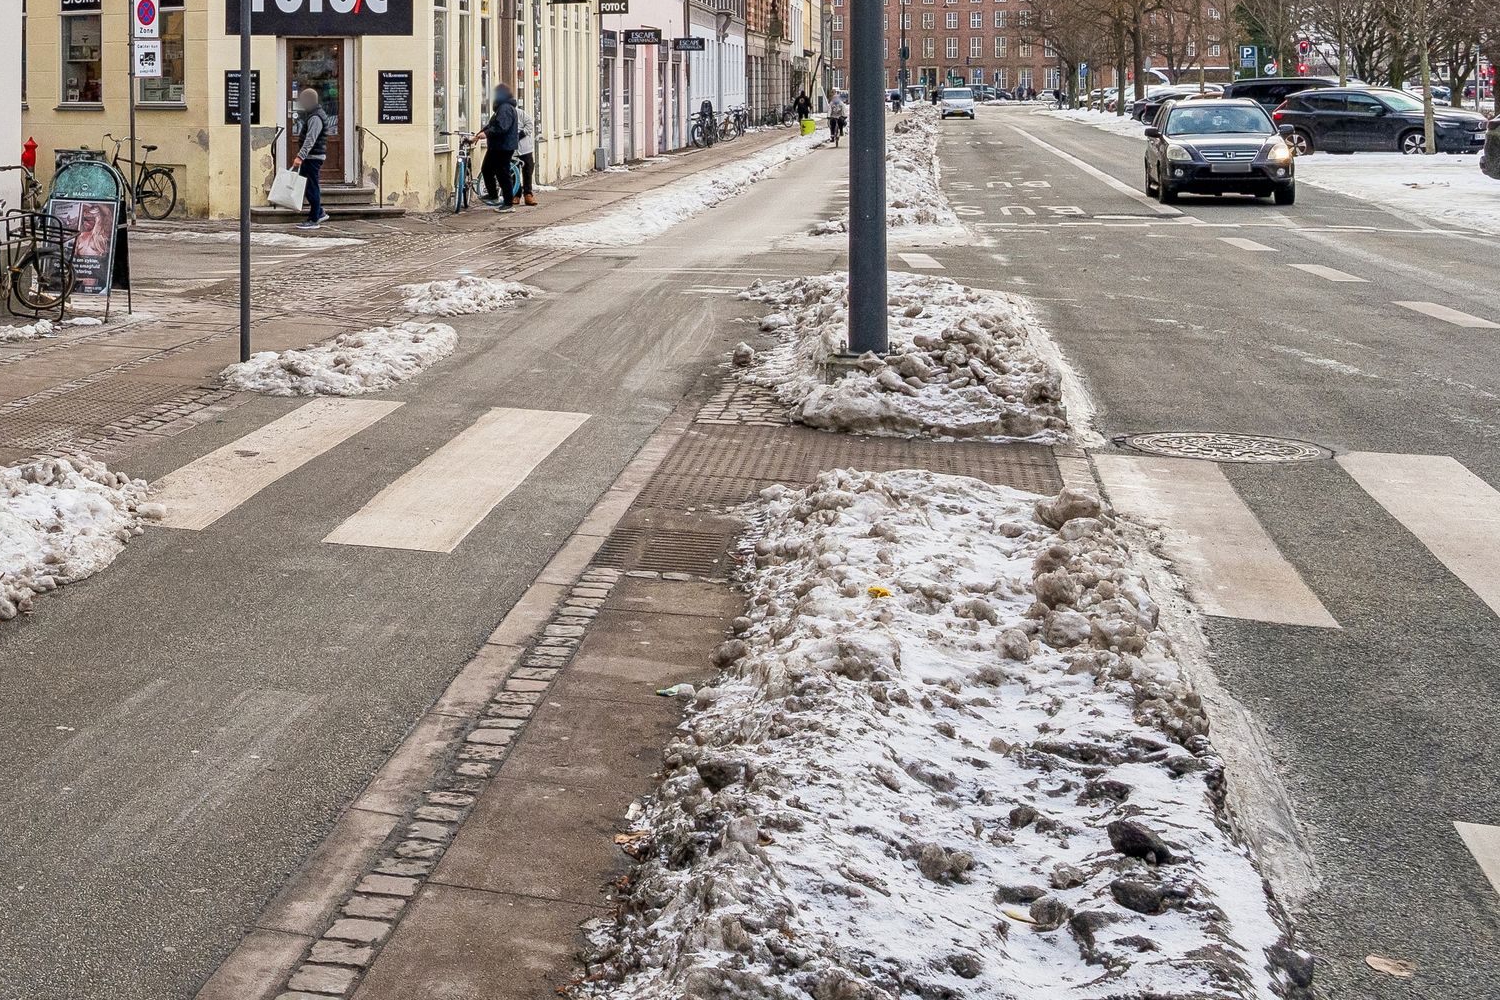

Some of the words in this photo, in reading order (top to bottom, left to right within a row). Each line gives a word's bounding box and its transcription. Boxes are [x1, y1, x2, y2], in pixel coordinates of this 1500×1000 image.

[601, 3, 619, 11] FOTO
[1244, 48, 1252, 58] P
[953, 206, 1086, 215] BUS
